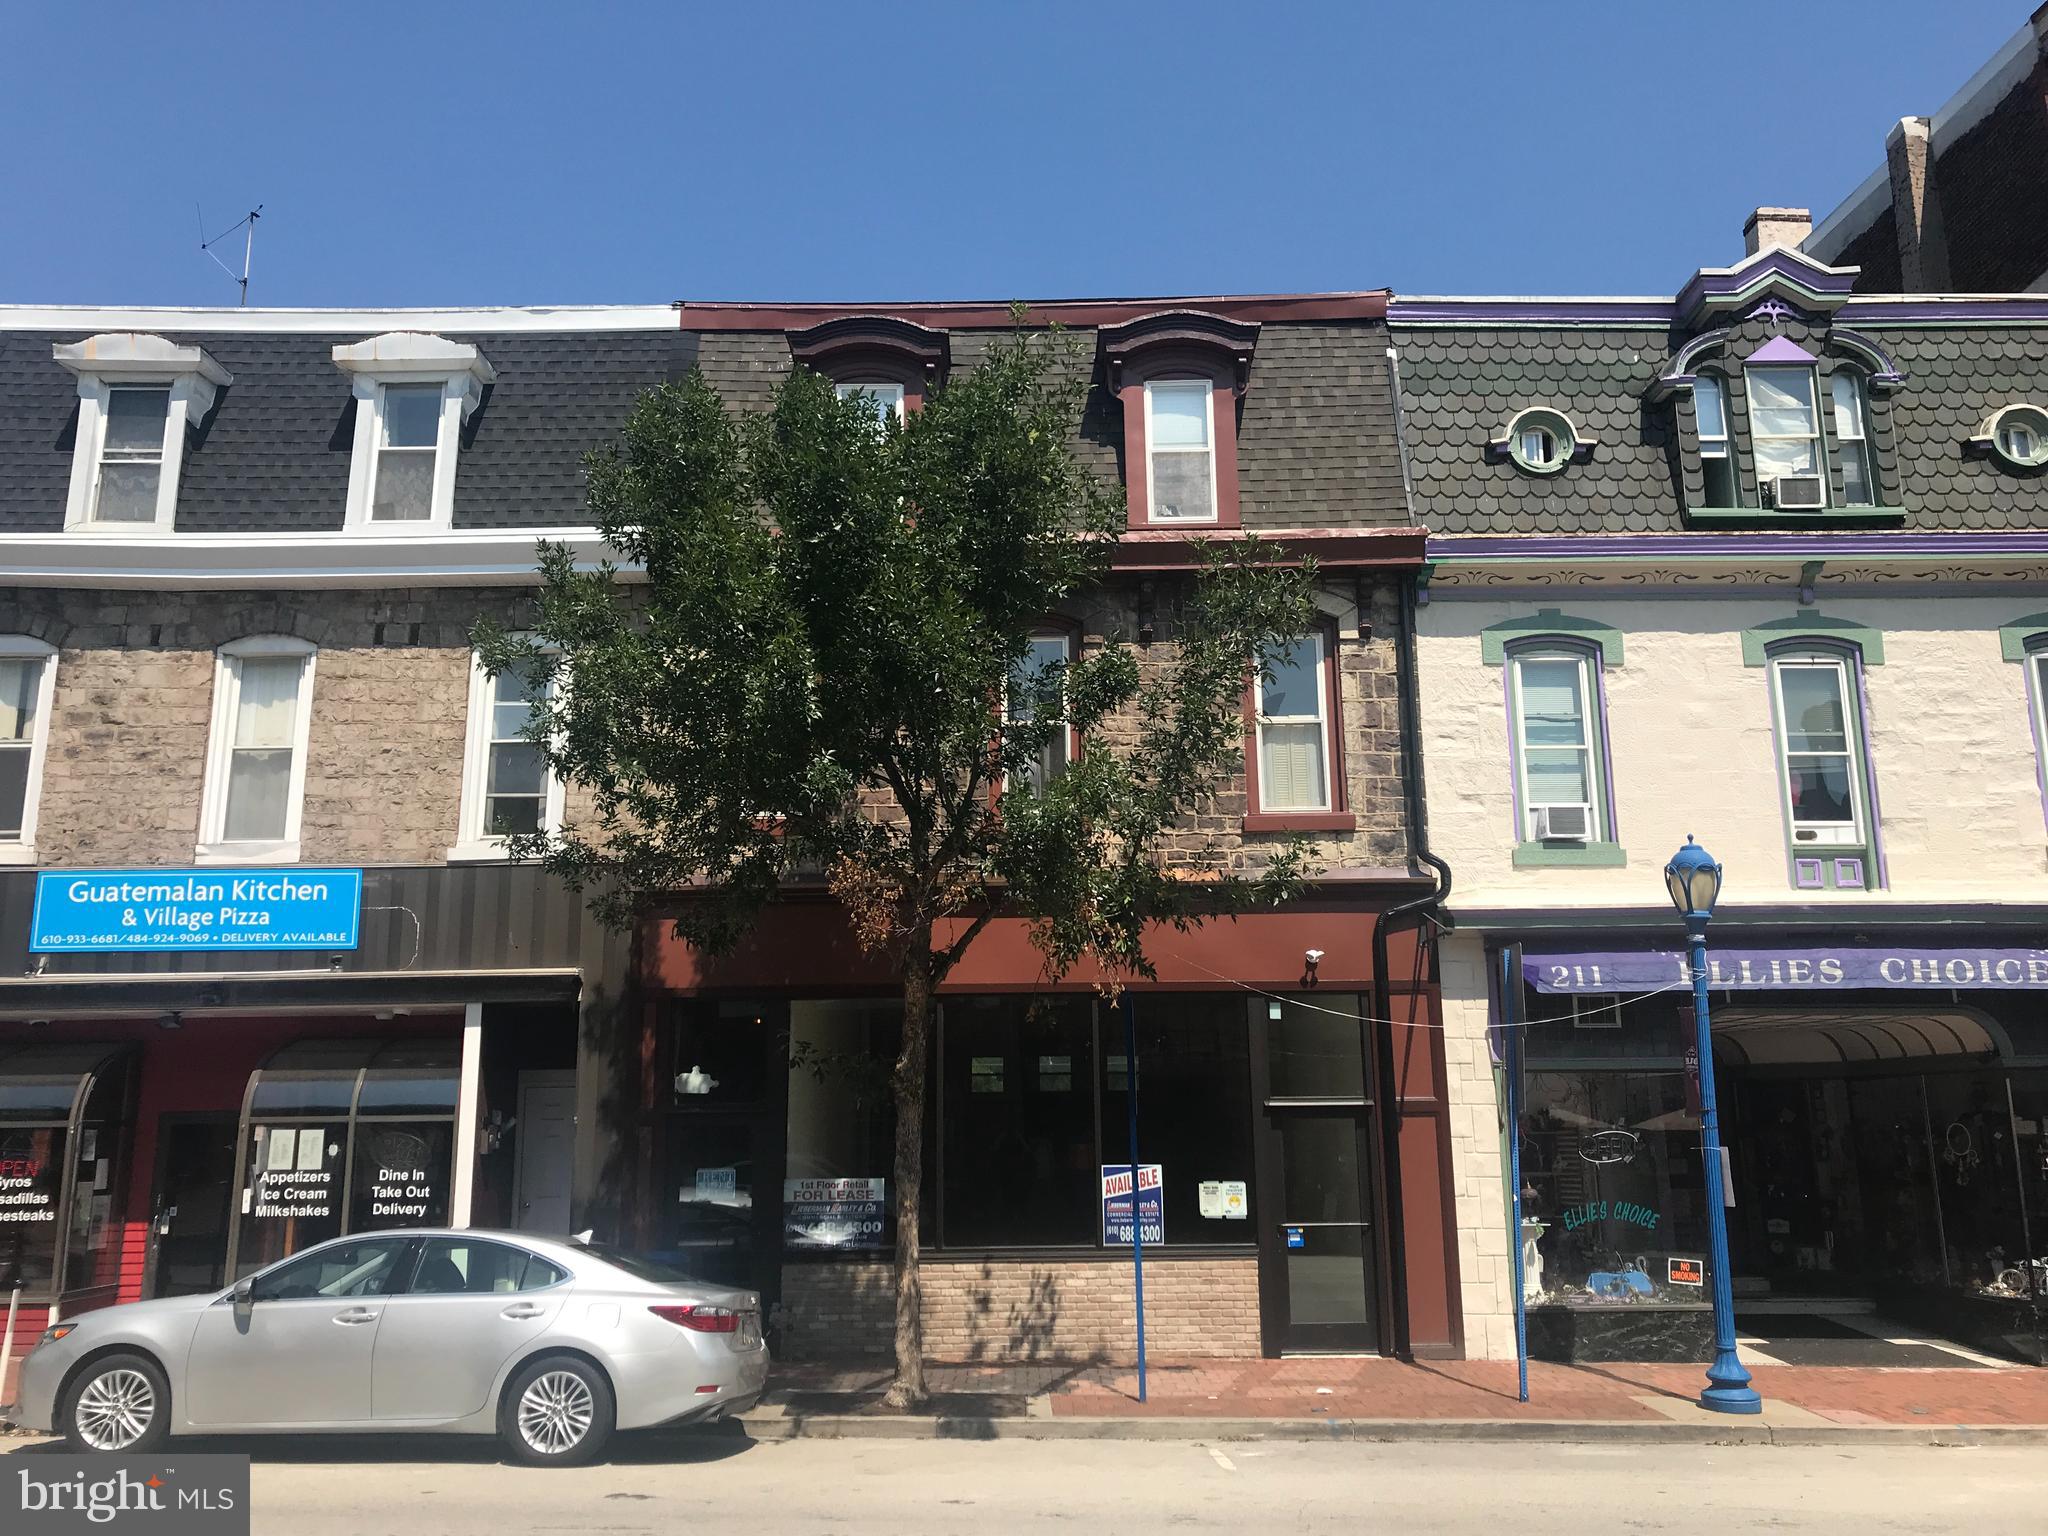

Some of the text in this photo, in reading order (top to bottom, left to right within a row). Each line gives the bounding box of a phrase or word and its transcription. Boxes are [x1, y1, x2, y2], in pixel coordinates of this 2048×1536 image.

[68, 877, 328, 903] Guatemalan Kitchen
[121, 907, 270, 931] & Village Pizza
[41, 932, 347, 945] 610-933-6681/484-924-9069 DELIVERY AVAILABLE
[1550, 965, 1604, 988] 211
[1879, 957, 2048, 984] CHOICE
[0, 1160, 39, 1177] PEN
[378, 1168, 425, 1182] Dine In
[259, 1171, 331, 1186] Appetizers
[800, 1180, 870, 1190] 1st Floor Retail
[1105, 1168, 1159, 1196] AVAILBLE
[260, 1187, 328, 1200] Ice Cream
[371, 1185, 431, 1198] Take Out
[793, 1190, 875, 1201] FOR LEASE
[255, 1204, 330, 1218] Milkshakes
[372, 1202, 427, 1217] Delivery
[1613, 1201, 1661, 1229] CHOICE
[1106, 1224, 1161, 1242] (610) 6884300
[1680, 1262, 1691, 1272] NO
[1671, 1271, 1700, 1283] SMOKING
